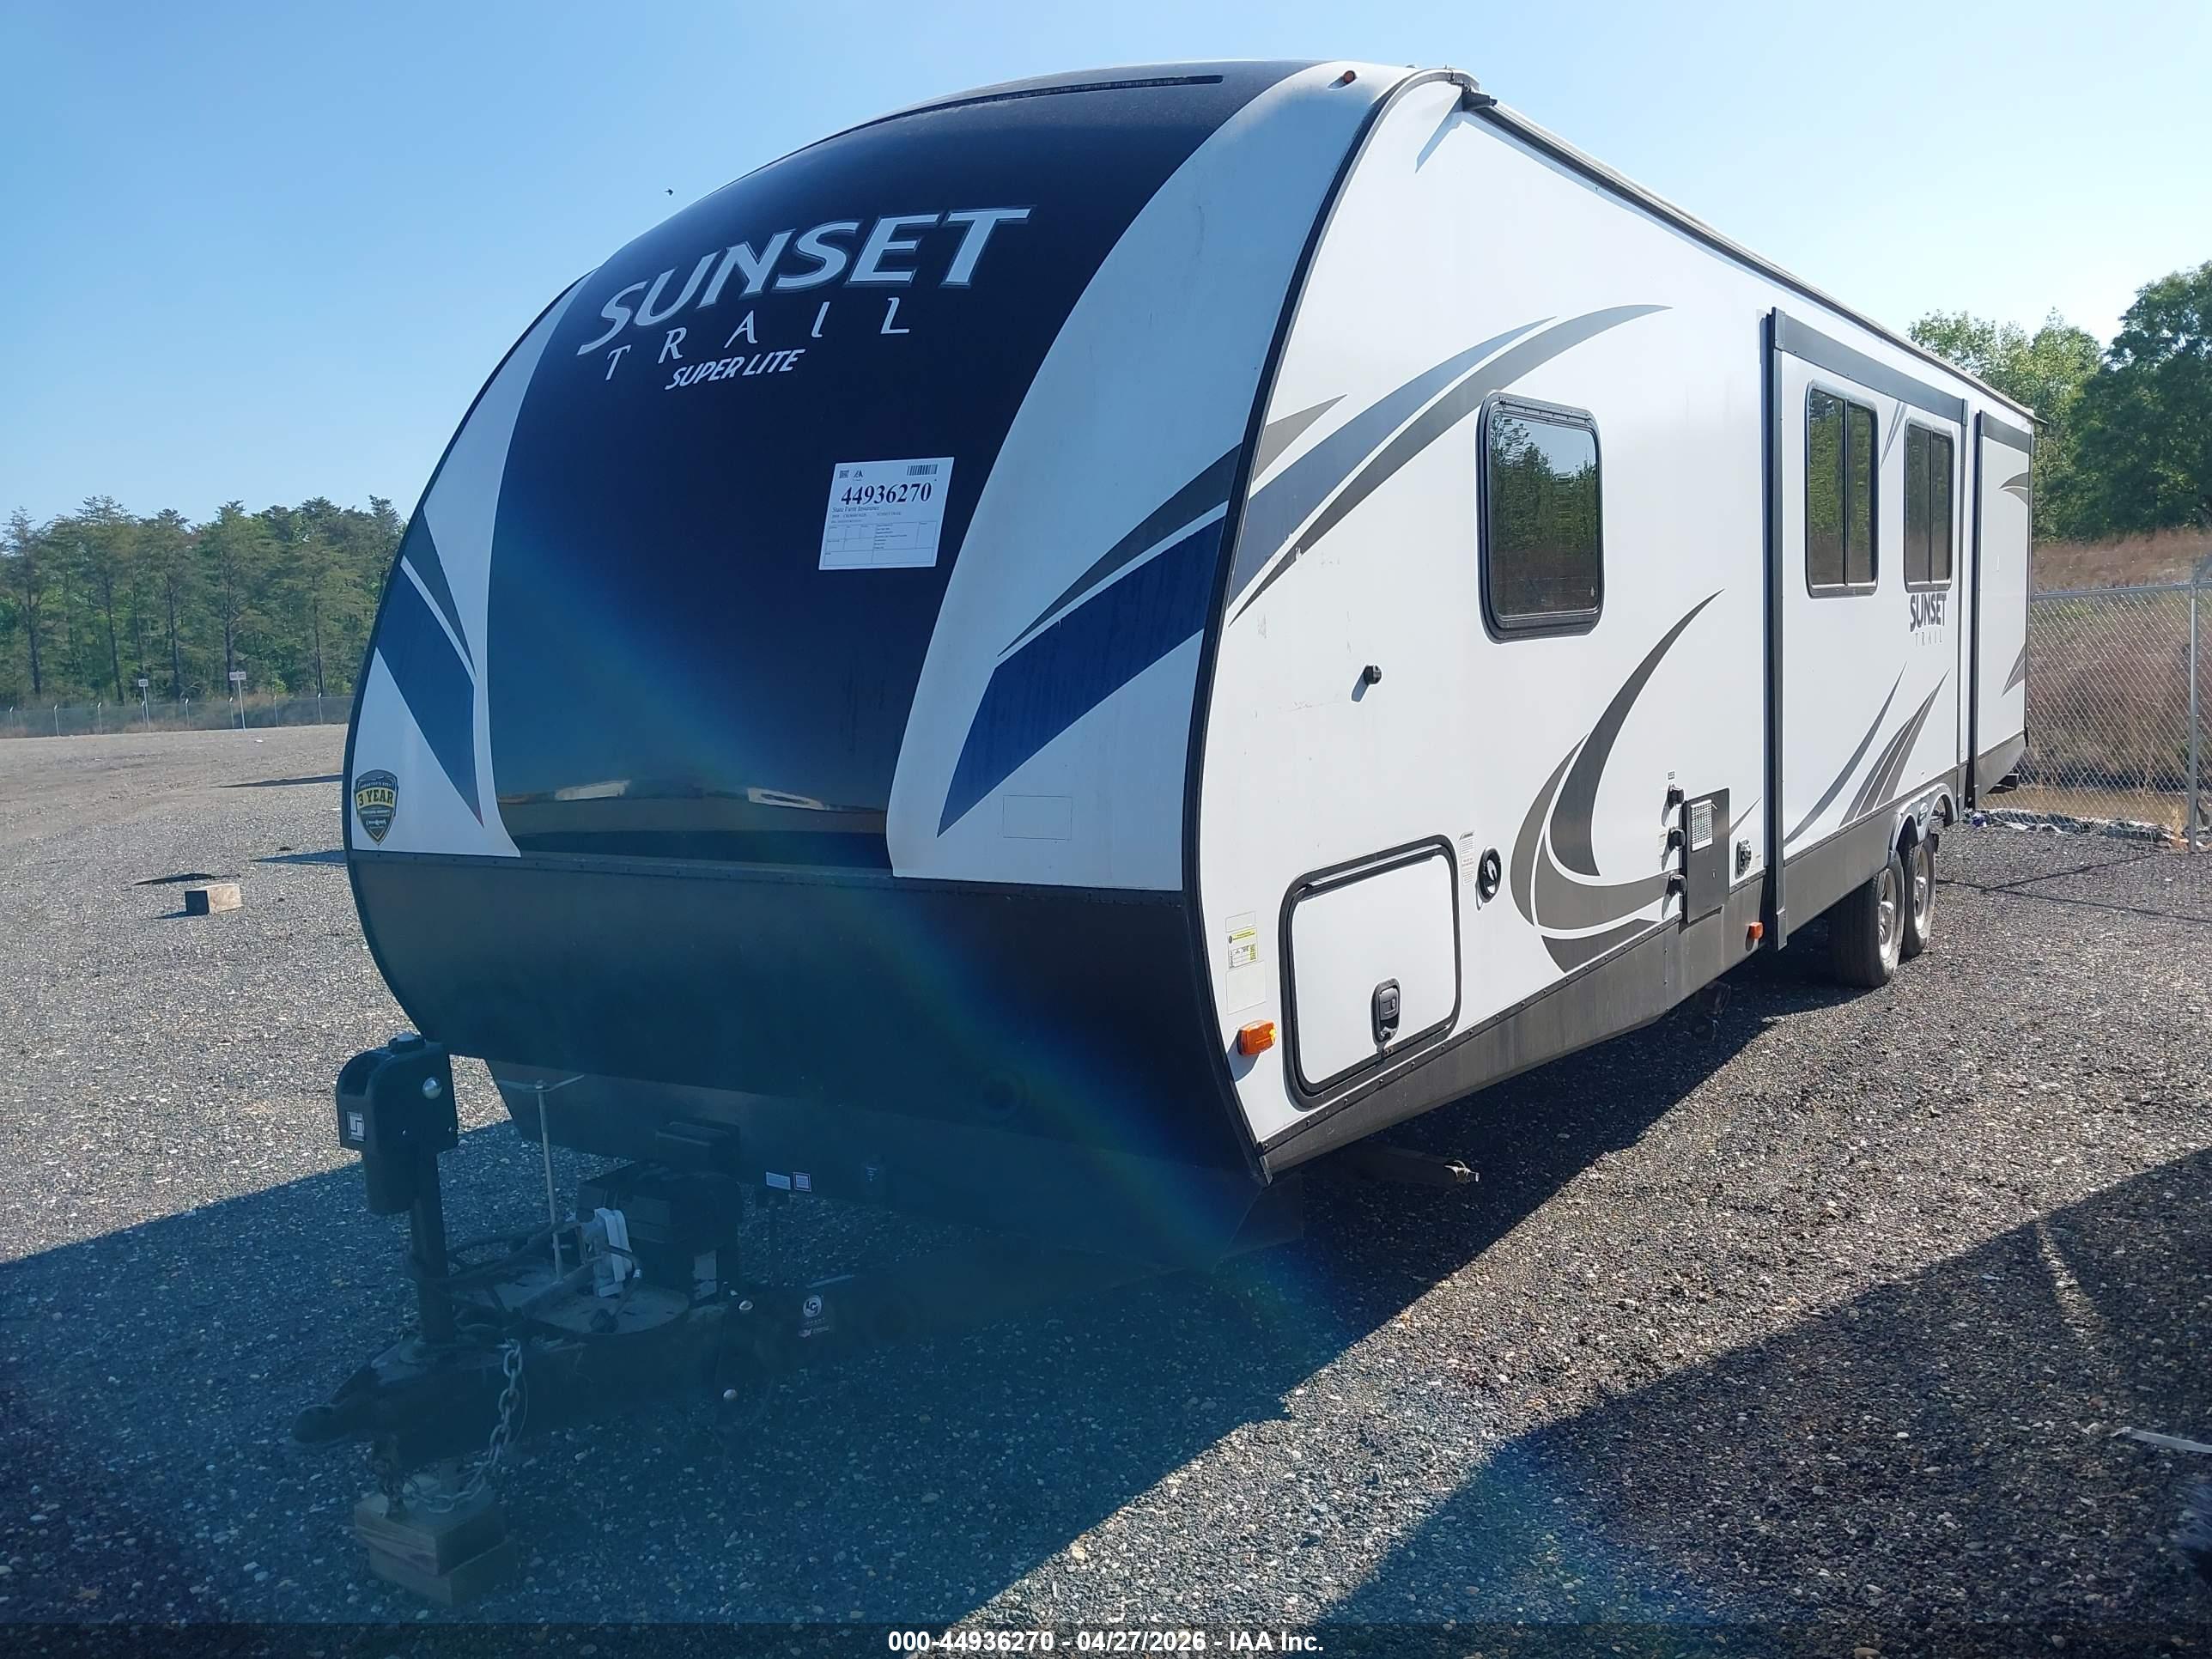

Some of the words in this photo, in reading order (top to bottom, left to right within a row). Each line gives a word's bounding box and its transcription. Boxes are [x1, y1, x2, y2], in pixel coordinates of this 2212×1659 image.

[576, 207, 1031, 356] SUNSET
[604, 296, 910, 381] TRAIL
[665, 356, 749, 391] SUPER
[743, 349, 806, 375] LITE
[840, 482, 933, 506] 44936270
[1909, 592, 1948, 633] SUNSET
[1914, 629, 1943, 647] TRAIL
[357, 793, 364, 807] 3
[366, 789, 394, 805] YEAR
